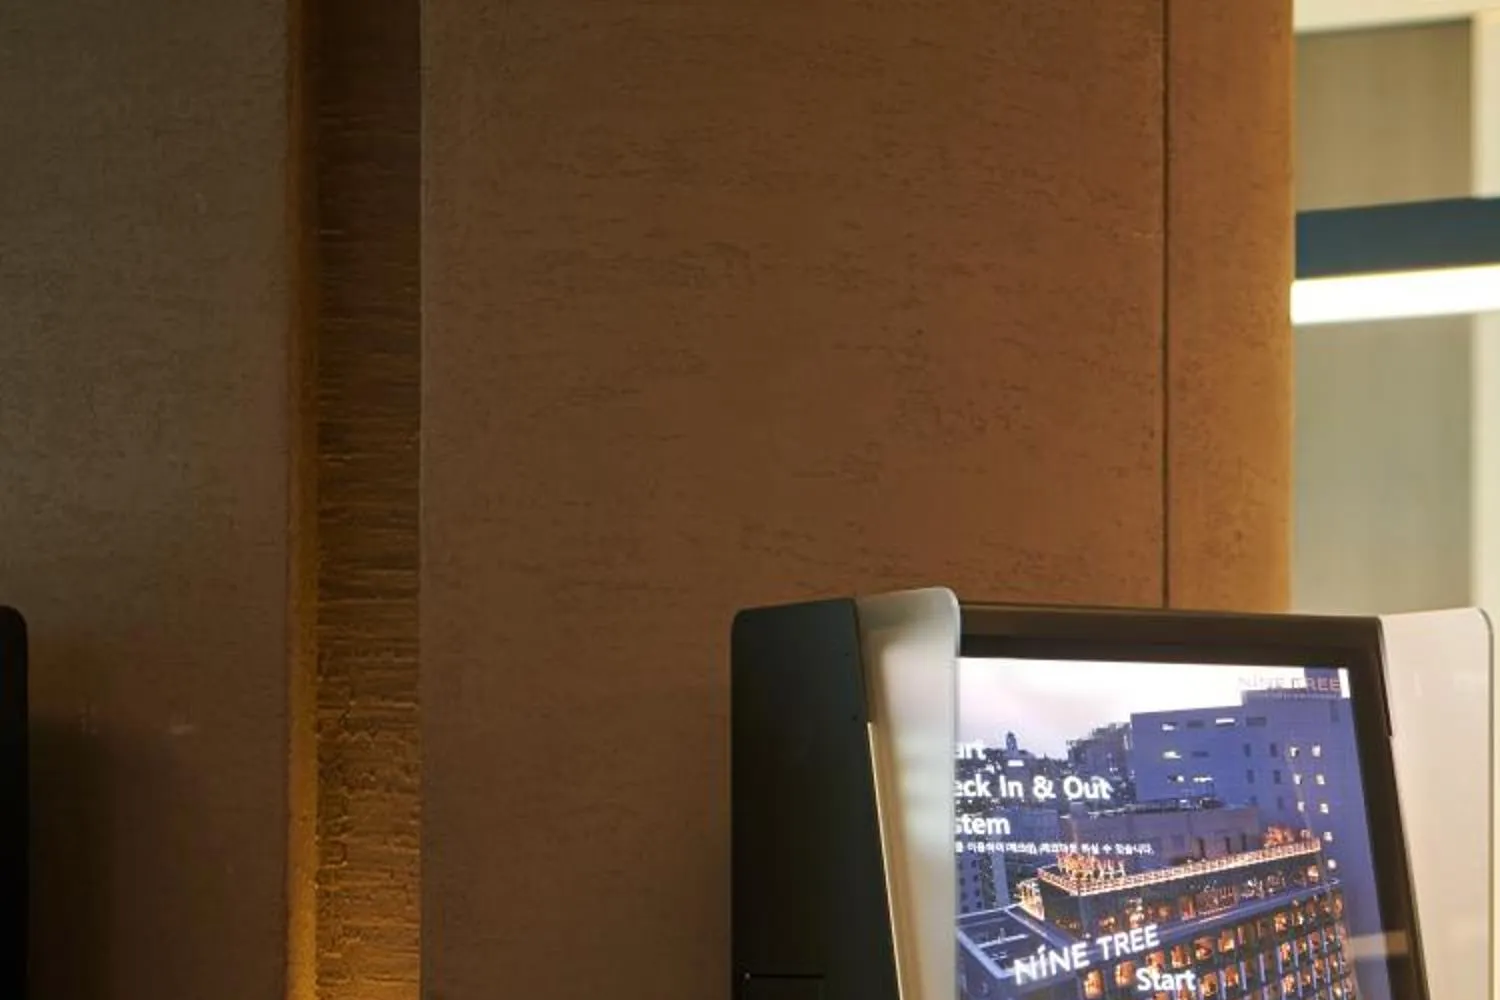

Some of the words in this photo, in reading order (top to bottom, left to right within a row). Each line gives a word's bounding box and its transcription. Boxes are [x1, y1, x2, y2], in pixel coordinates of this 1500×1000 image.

[954, 773, 992, 797] eck
[1000, 775, 1024, 798] In
[1033, 774, 1057, 800] &
[1063, 774, 1113, 800] Out
[955, 814, 1011, 835] stem
[1096, 923, 1162, 961] TREE
[1136, 967, 1198, 993] Start
